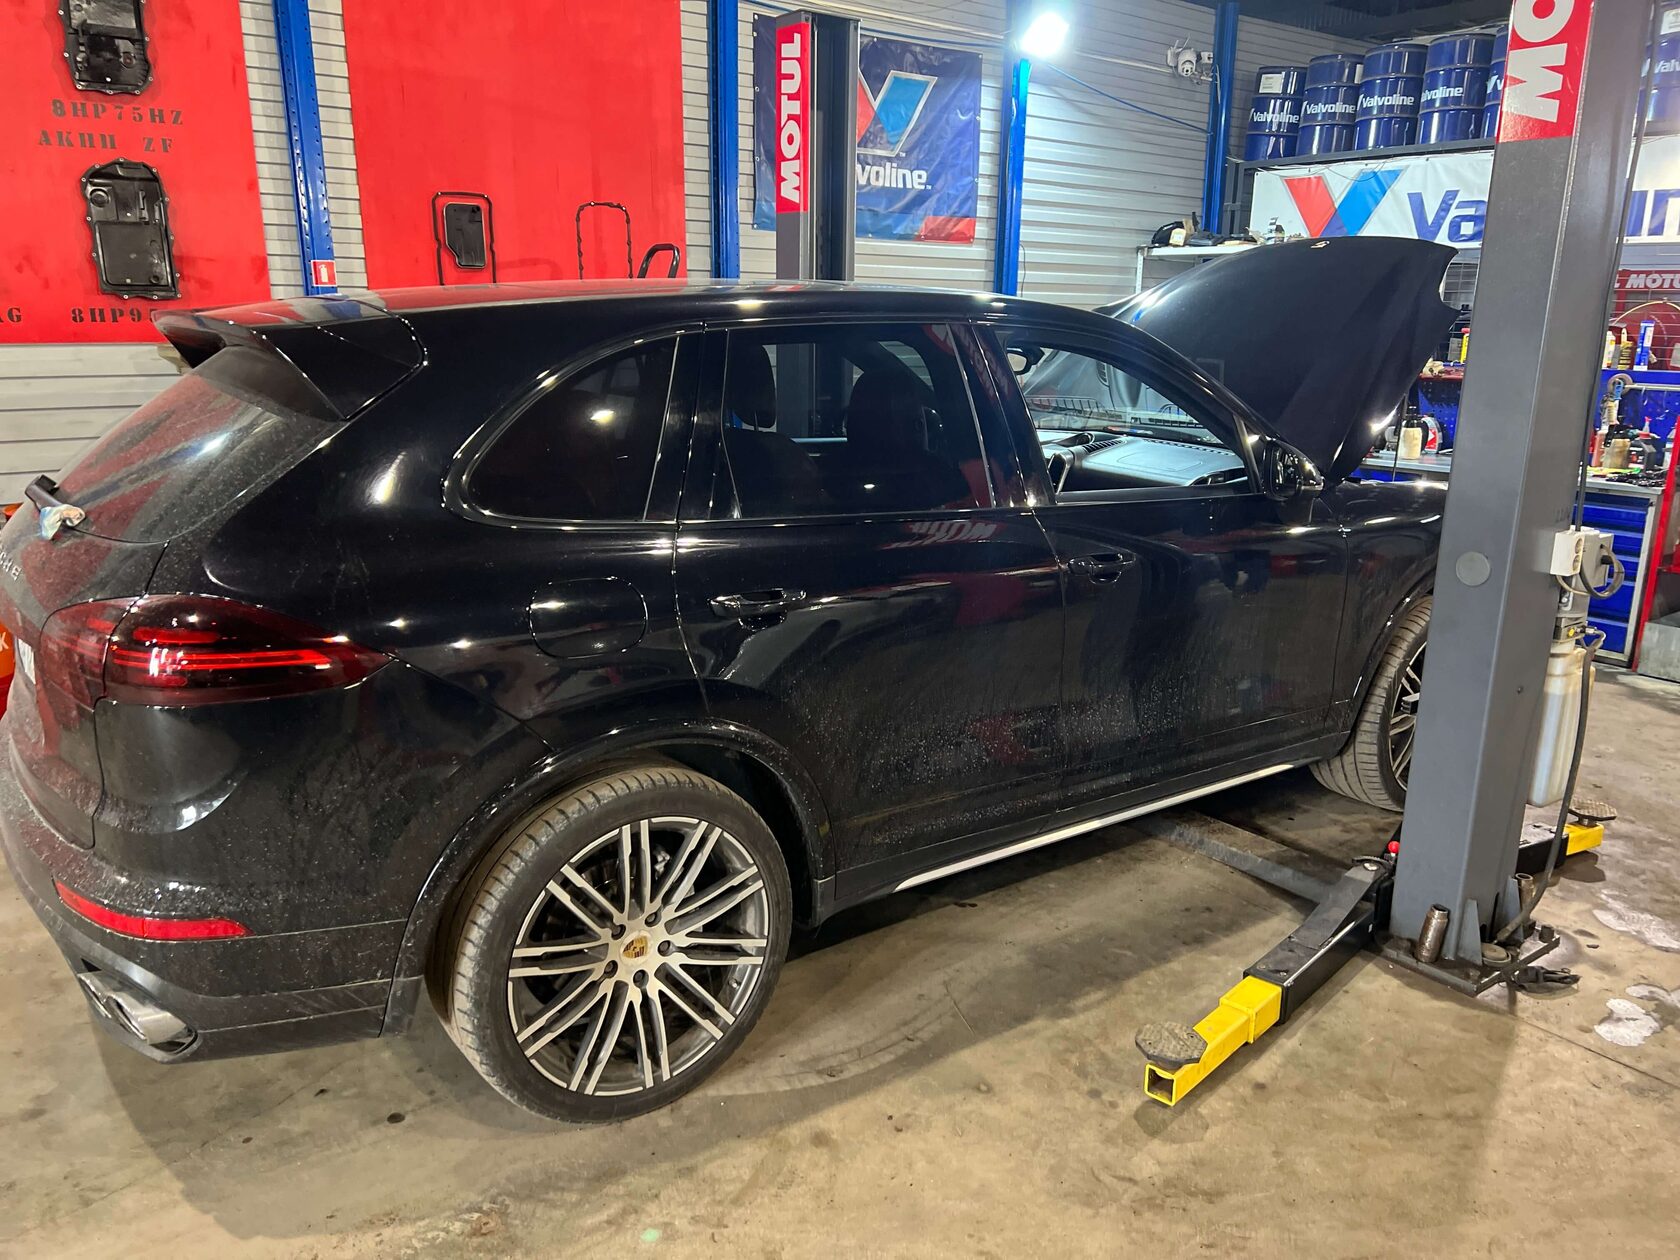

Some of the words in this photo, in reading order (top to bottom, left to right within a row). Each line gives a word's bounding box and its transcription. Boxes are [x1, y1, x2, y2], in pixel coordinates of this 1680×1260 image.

[1305, 102, 1356, 115] Valvoline
[1361, 94, 1415, 108] Valvoline
[51, 99, 183, 125] 8HP75HZ
[780, 33, 802, 204] MOTUL
[1252, 111, 1300, 123] Valvoline
[143, 137, 174, 152] ZF
[856, 162, 928, 190] voline
